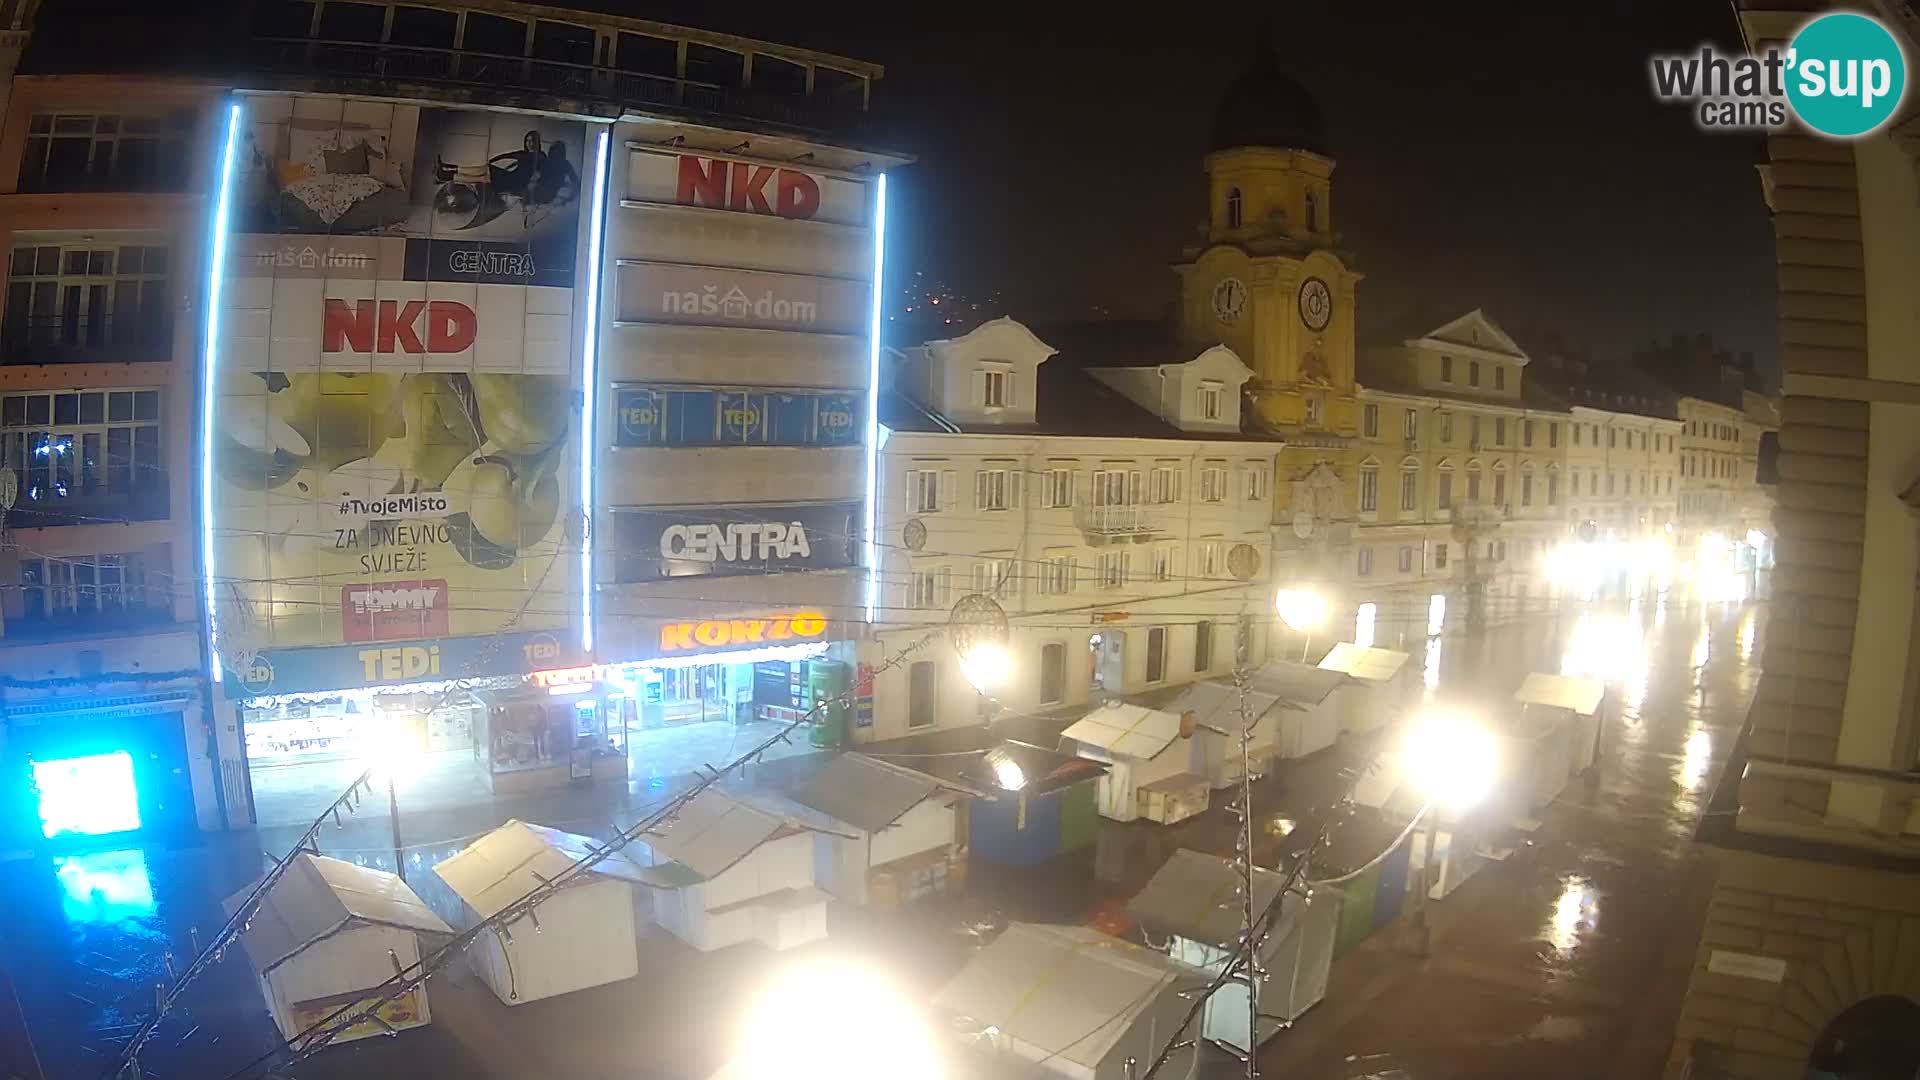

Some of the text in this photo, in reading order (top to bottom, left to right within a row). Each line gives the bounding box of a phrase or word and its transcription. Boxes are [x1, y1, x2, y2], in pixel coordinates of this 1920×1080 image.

[676, 154, 820, 219] NKD
[449, 249, 536, 276] CENTRA
[661, 285, 817, 324] naš dom
[322, 298, 478, 353] NKD
[723, 410, 760, 425] TEDi
[340, 497, 447, 516] #TvojeMisto
[335, 524, 450, 549] ZA DNEVNO
[660, 521, 810, 562] CENTRA
[361, 547, 427, 575] SVJEŽE
[350, 587, 438, 614] TOMMY
[240, 666, 274, 683] EDi
[359, 645, 440, 681] TEDi
